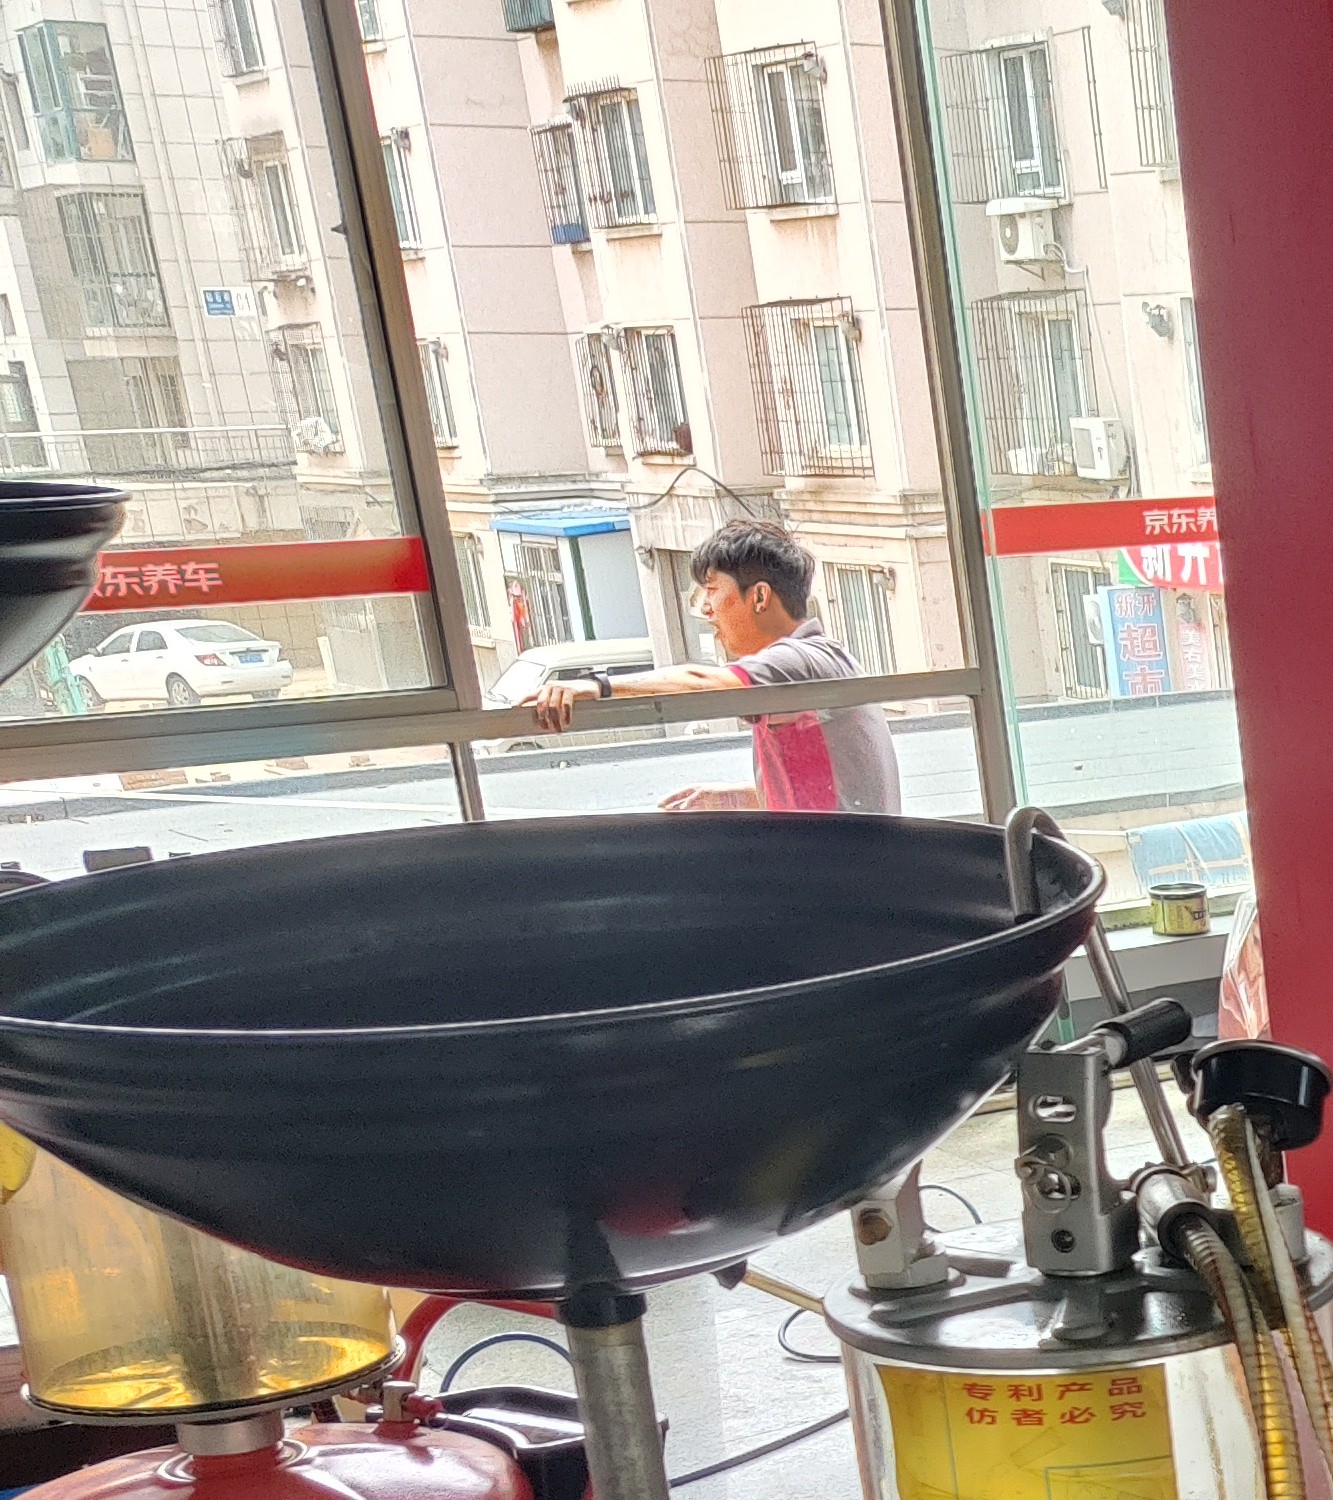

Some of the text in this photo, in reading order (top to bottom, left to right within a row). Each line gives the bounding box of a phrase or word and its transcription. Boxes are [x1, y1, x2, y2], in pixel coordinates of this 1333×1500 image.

[92, 560, 223, 598] 东养车
[1140, 543, 1223, 586] 新开
[1115, 592, 1157, 619] 新开
[1118, 623, 1165, 695] 超市
[962, 1375, 1143, 1403] 专利产品
[965, 1401, 1147, 1427] 仿者必究
